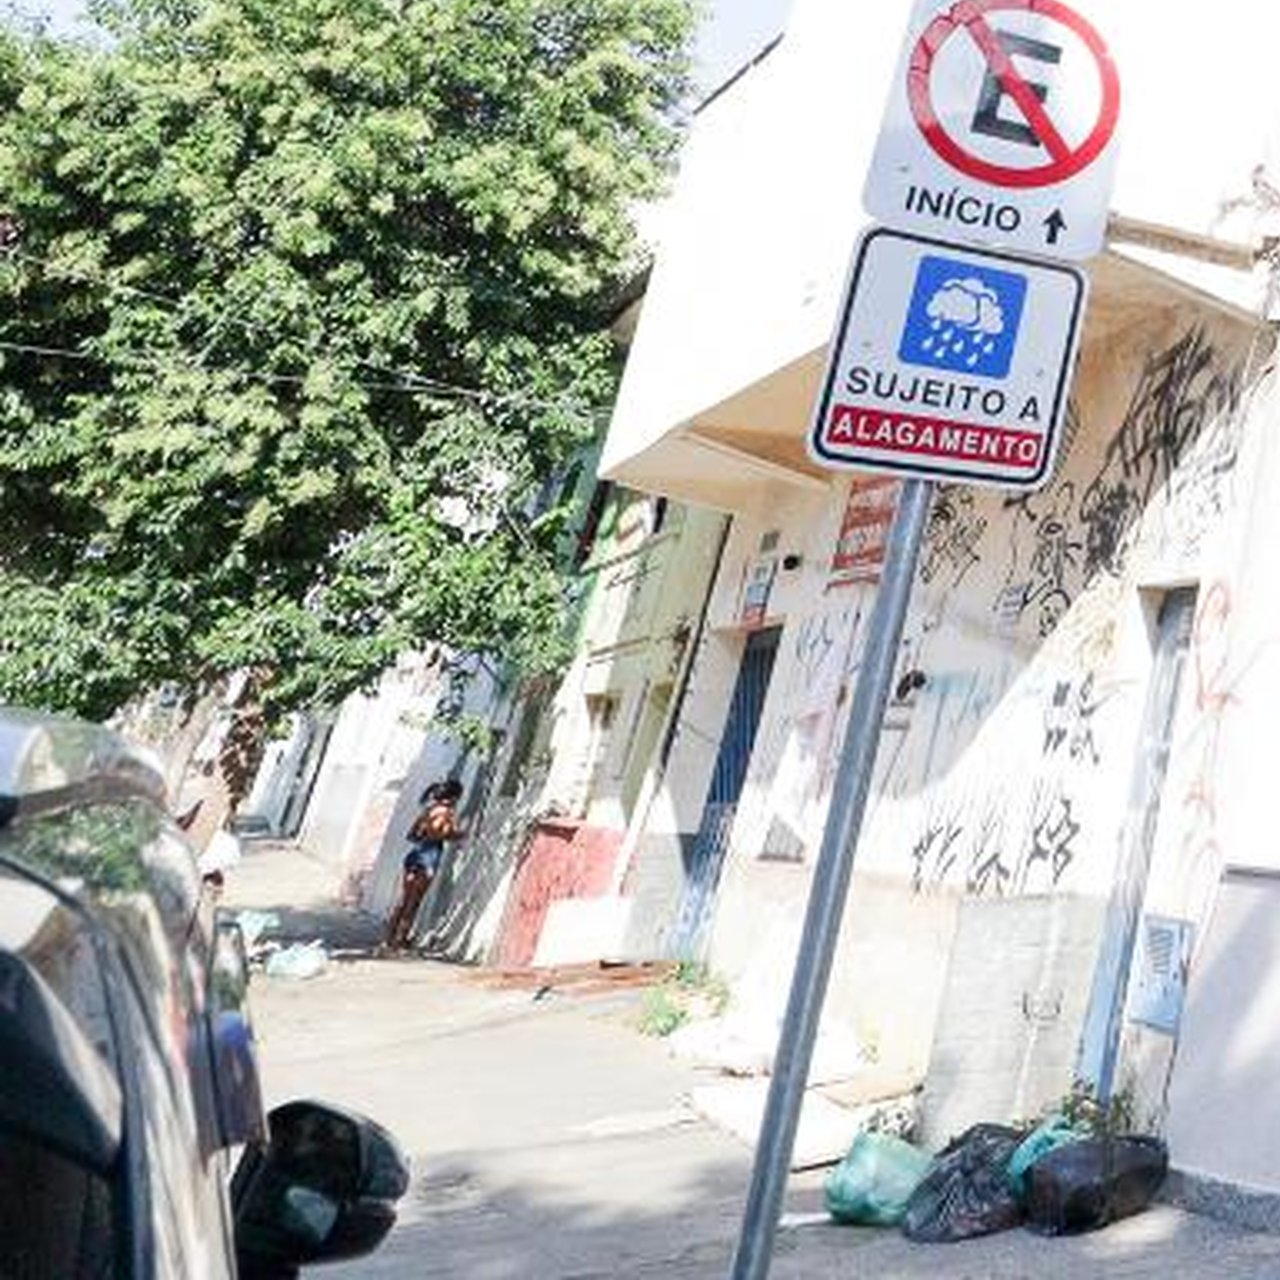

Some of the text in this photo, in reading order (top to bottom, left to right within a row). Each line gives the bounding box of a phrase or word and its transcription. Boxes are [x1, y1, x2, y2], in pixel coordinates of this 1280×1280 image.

[971, 29, 1062, 147] E
[904, 184, 1022, 234] INÍCIO
[846, 366, 1041, 421] SUJEITO A
[833, 411, 1040, 462] ALAGAMENTO
